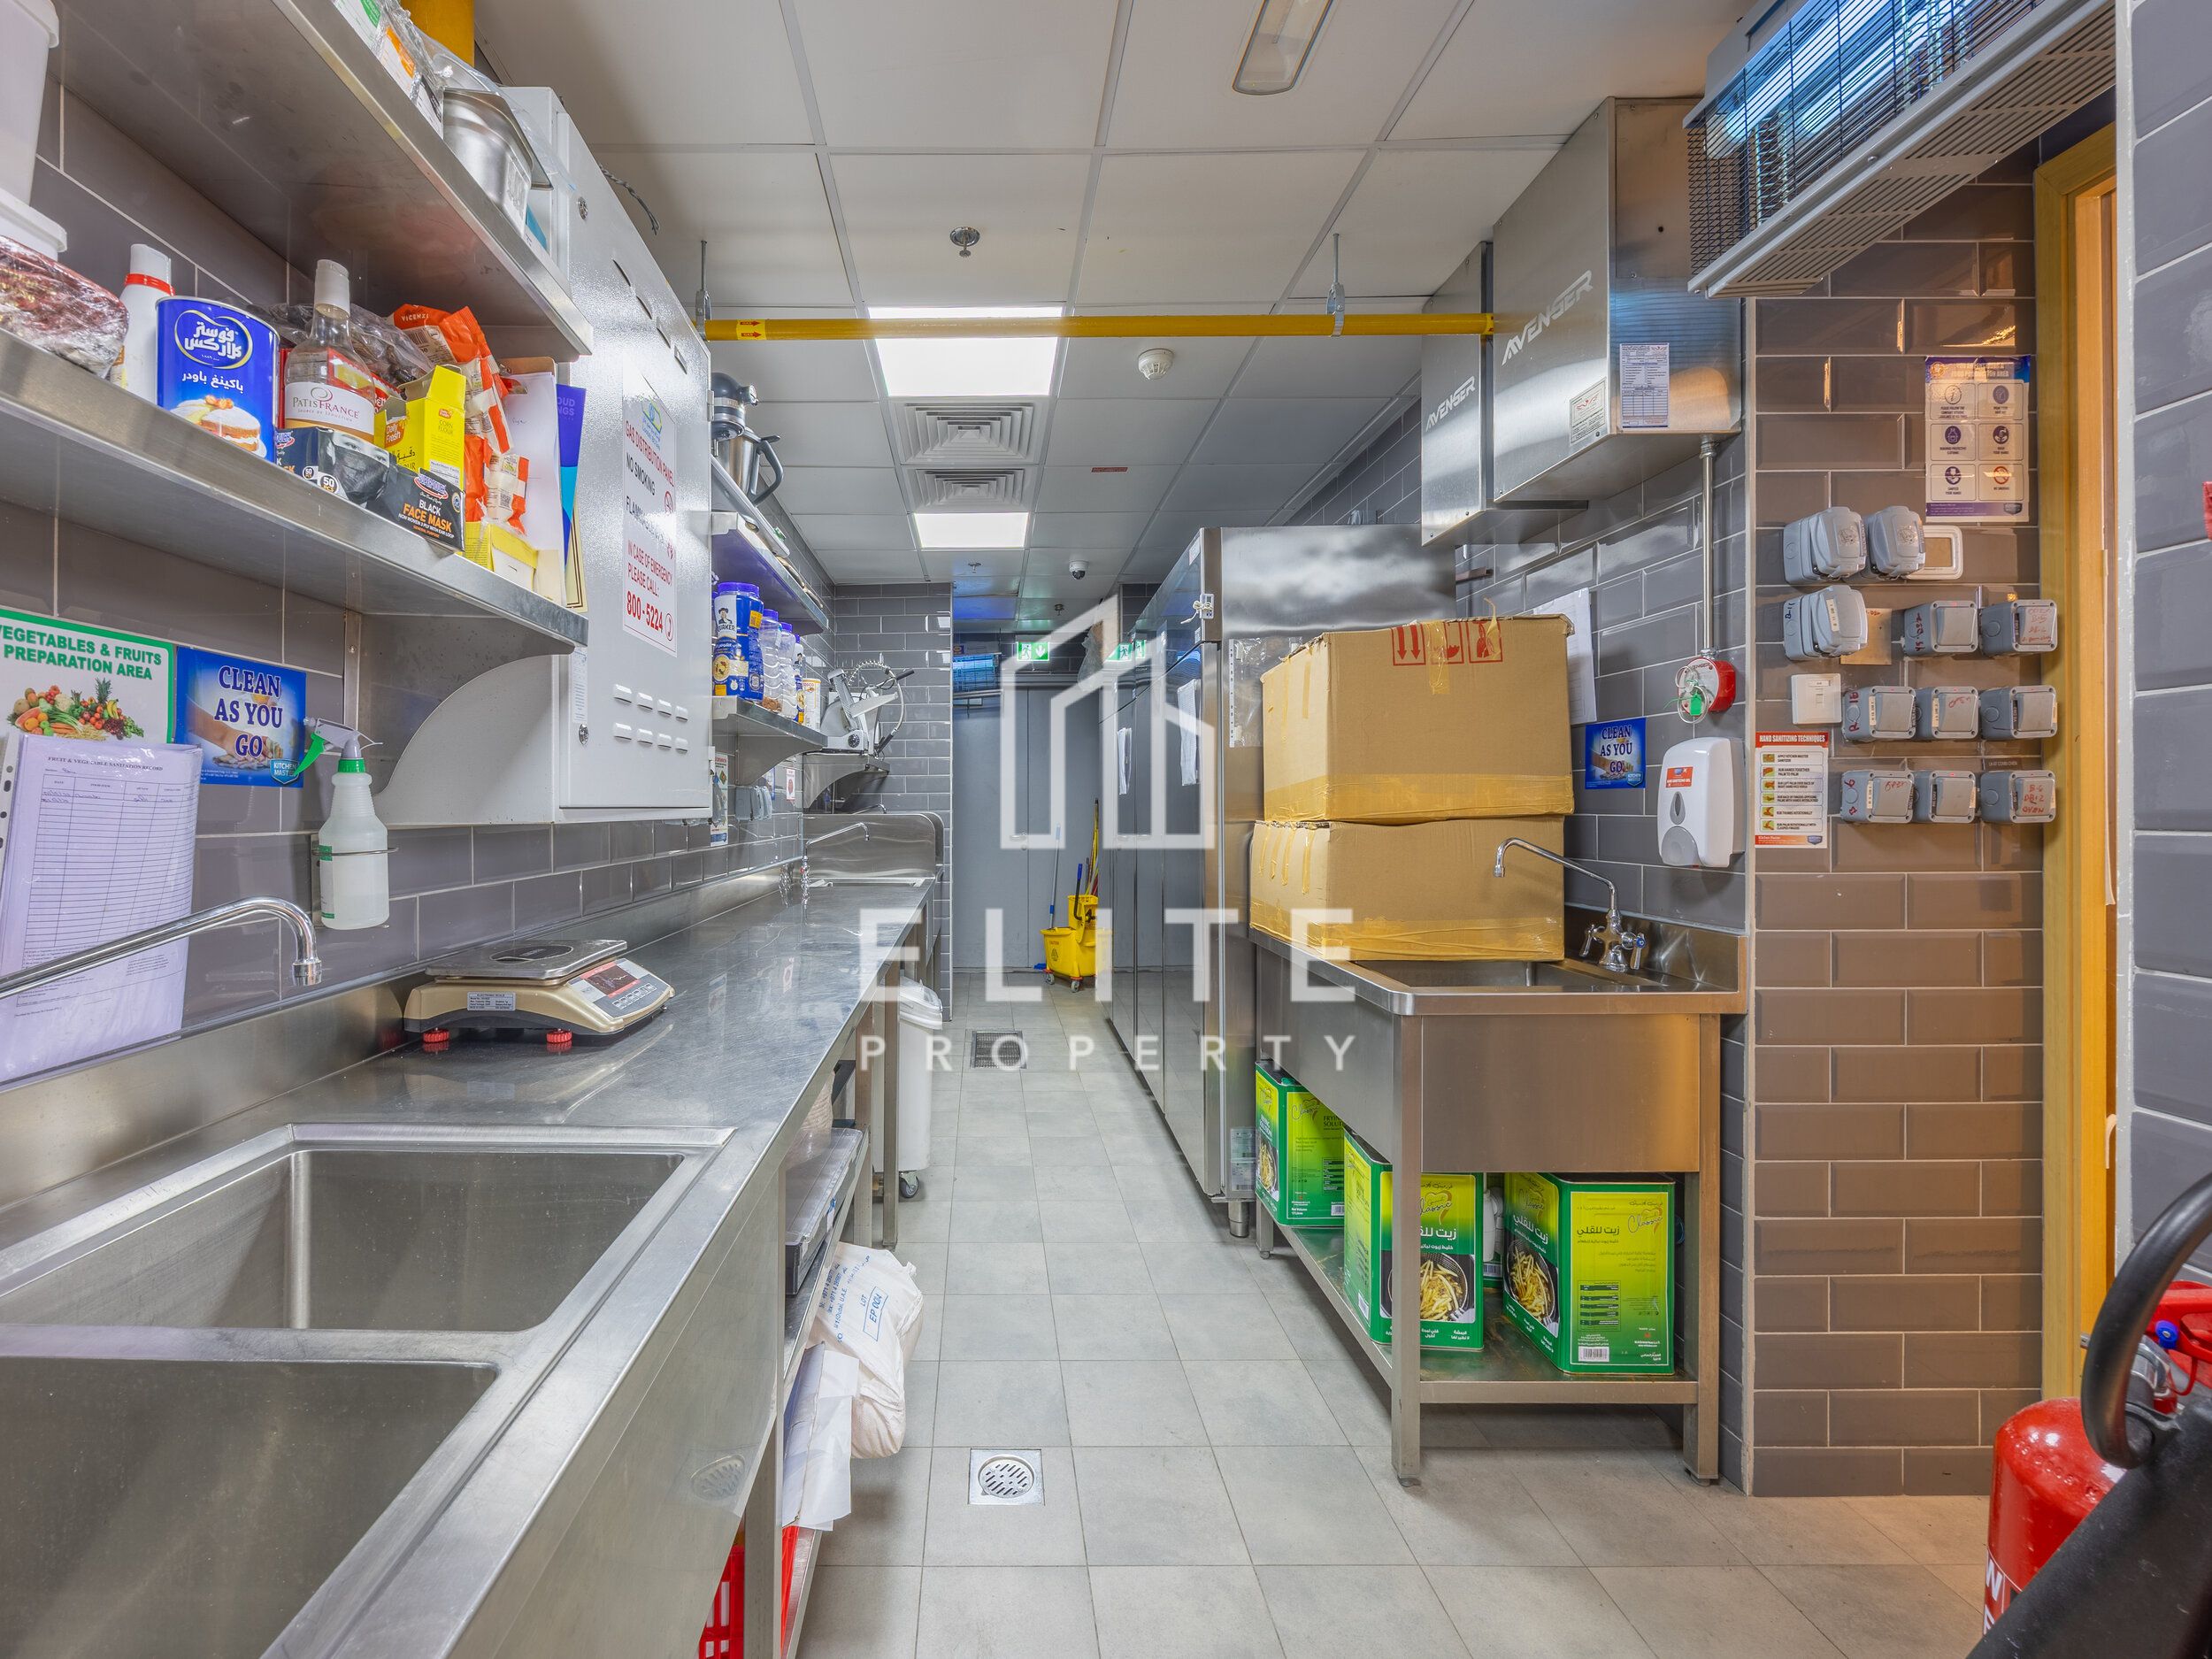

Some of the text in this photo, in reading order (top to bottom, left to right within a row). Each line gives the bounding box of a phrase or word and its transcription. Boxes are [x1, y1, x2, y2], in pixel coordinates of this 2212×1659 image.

[181, 371, 244, 394] باكينغ باودر
[386, 432, 401, 443] Fresh
[626, 420, 634, 443] GAS
[322, 476, 334, 488] 50
[626, 452, 634, 473] NO
[634, 462, 656, 496] SMOKING
[419, 497, 442, 517] BLACK
[403, 503, 452, 534] FACE MASK
[627, 539, 672, 587] IN CASE OF EMERGENCY
[627, 562, 646, 590] PLEASE
[718, 623, 736, 633] QUAKER
[0, 625, 162, 665] VEGETABLES & FRUITS
[4, 644, 152, 680] PREPARATION AREA
[218, 665, 281, 698] CLEAN
[214, 698, 283, 729] AS YOU
[1601, 725, 1632, 740] CLEAN
[235, 733, 263, 757] GO
[1600, 742, 1633, 757] AS YOU
[1609, 760, 1624, 773] GO
[1420, 1196, 1452, 1216] lassic
[1436, 1227, 1457, 1240] زيت
[1535, 1226, 1549, 1245] زيت
[1577, 1225, 1620, 1238] زيت للقلي
[860, 1294, 869, 1307] LOT
[869, 1309, 877, 1324] EP
